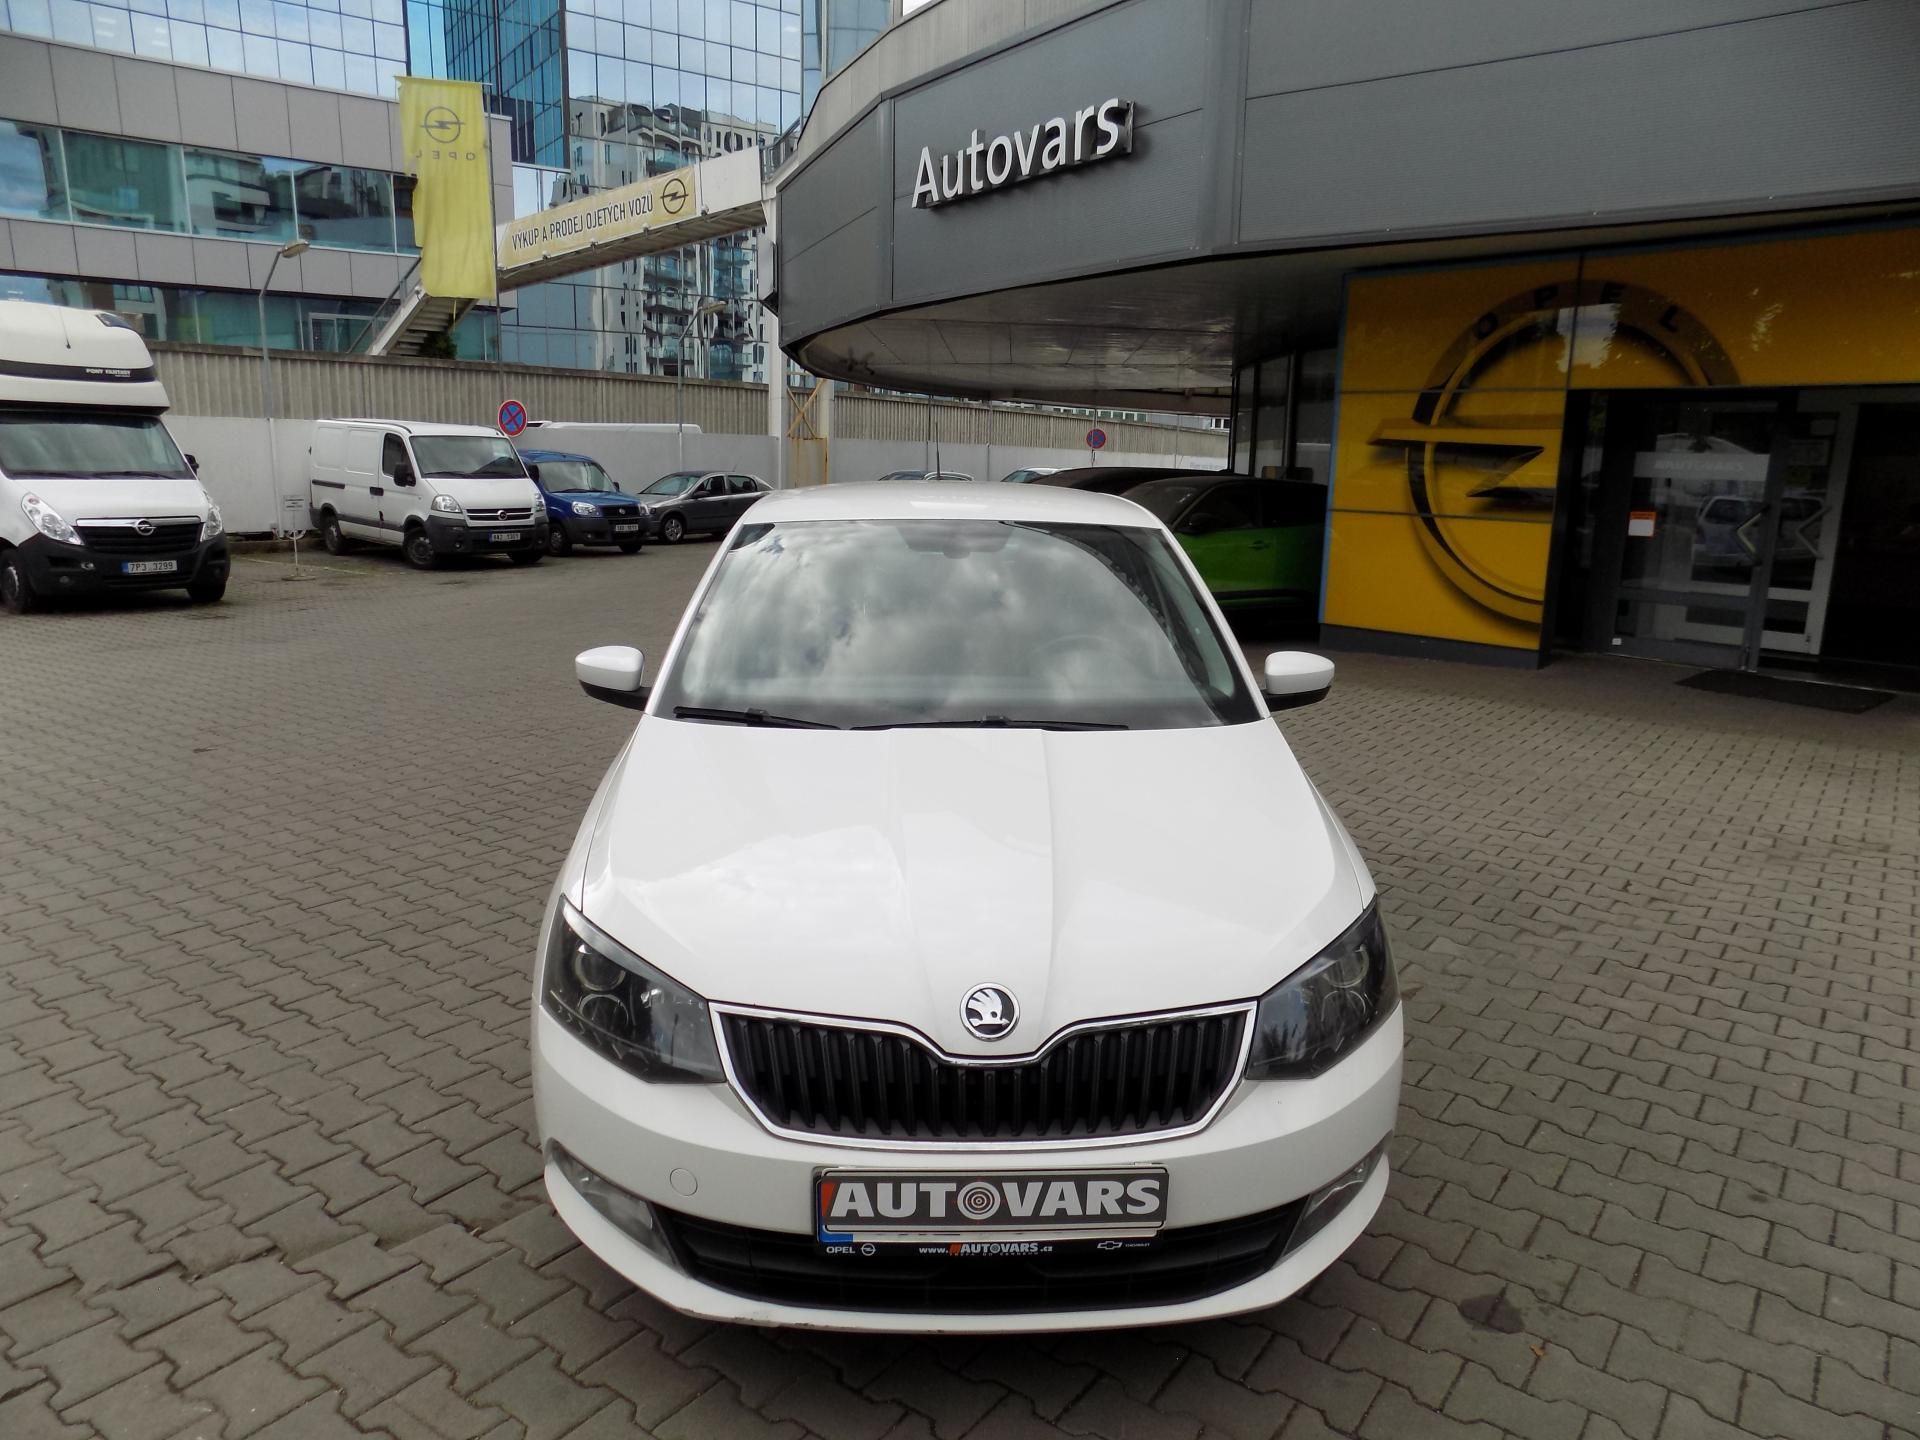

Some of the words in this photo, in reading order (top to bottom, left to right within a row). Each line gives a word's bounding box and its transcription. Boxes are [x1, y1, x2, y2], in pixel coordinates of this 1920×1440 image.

[911, 97, 1121, 208] Autovars
[541, 229, 548, 242] A
[550, 216, 584, 240] PRODEJ
[586, 202, 626, 230] OJETÝCH
[1473, 280, 1679, 340] OPEL
[129, 563, 147, 572] 7P3
[153, 561, 173, 571] 3299
[830, 1179, 1161, 1220] AUTOVARS
[826, 1246, 856, 1254] OPEL
